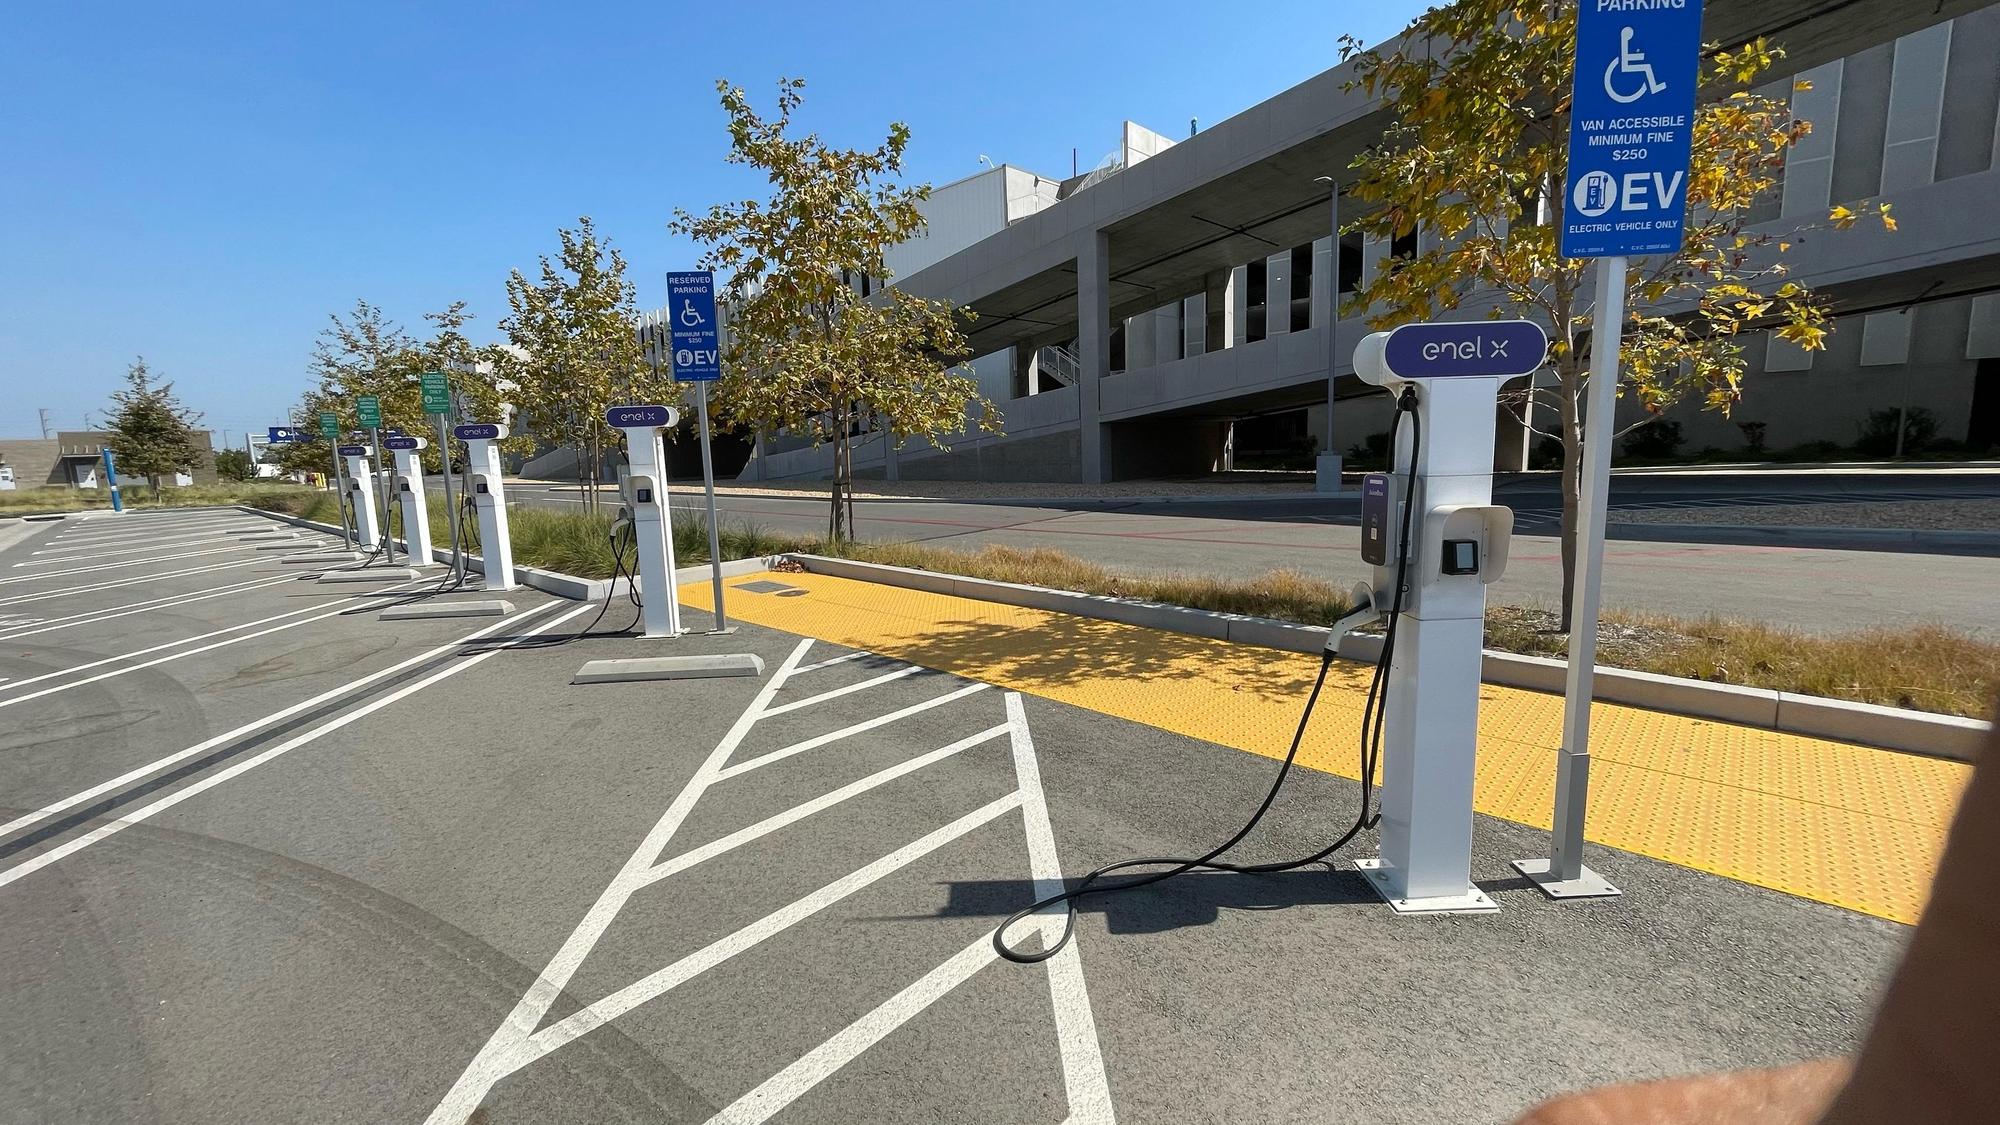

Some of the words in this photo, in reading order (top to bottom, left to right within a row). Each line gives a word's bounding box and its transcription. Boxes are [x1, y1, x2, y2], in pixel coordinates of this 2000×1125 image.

[1581, 119, 1604, 131] VAN
[1609, 115, 1685, 130] ACCESSIBLE
[1588, 133, 1643, 146] MINIMUM
[1647, 131, 1674, 143] FINE
[1621, 171, 1684, 211] EV
[1569, 223, 1612, 234] ELECTRIC
[1615, 221, 1652, 231] VEHICLE
[1655, 220, 1678, 230] ONLY
[669, 276, 711, 285] RESERVED
[673, 286, 708, 294] PARKING
[1422, 335, 1482, 361] enel
[694, 350, 718, 365] EV
[620, 411, 645, 422] enel
[463, 428, 481, 436] enel
